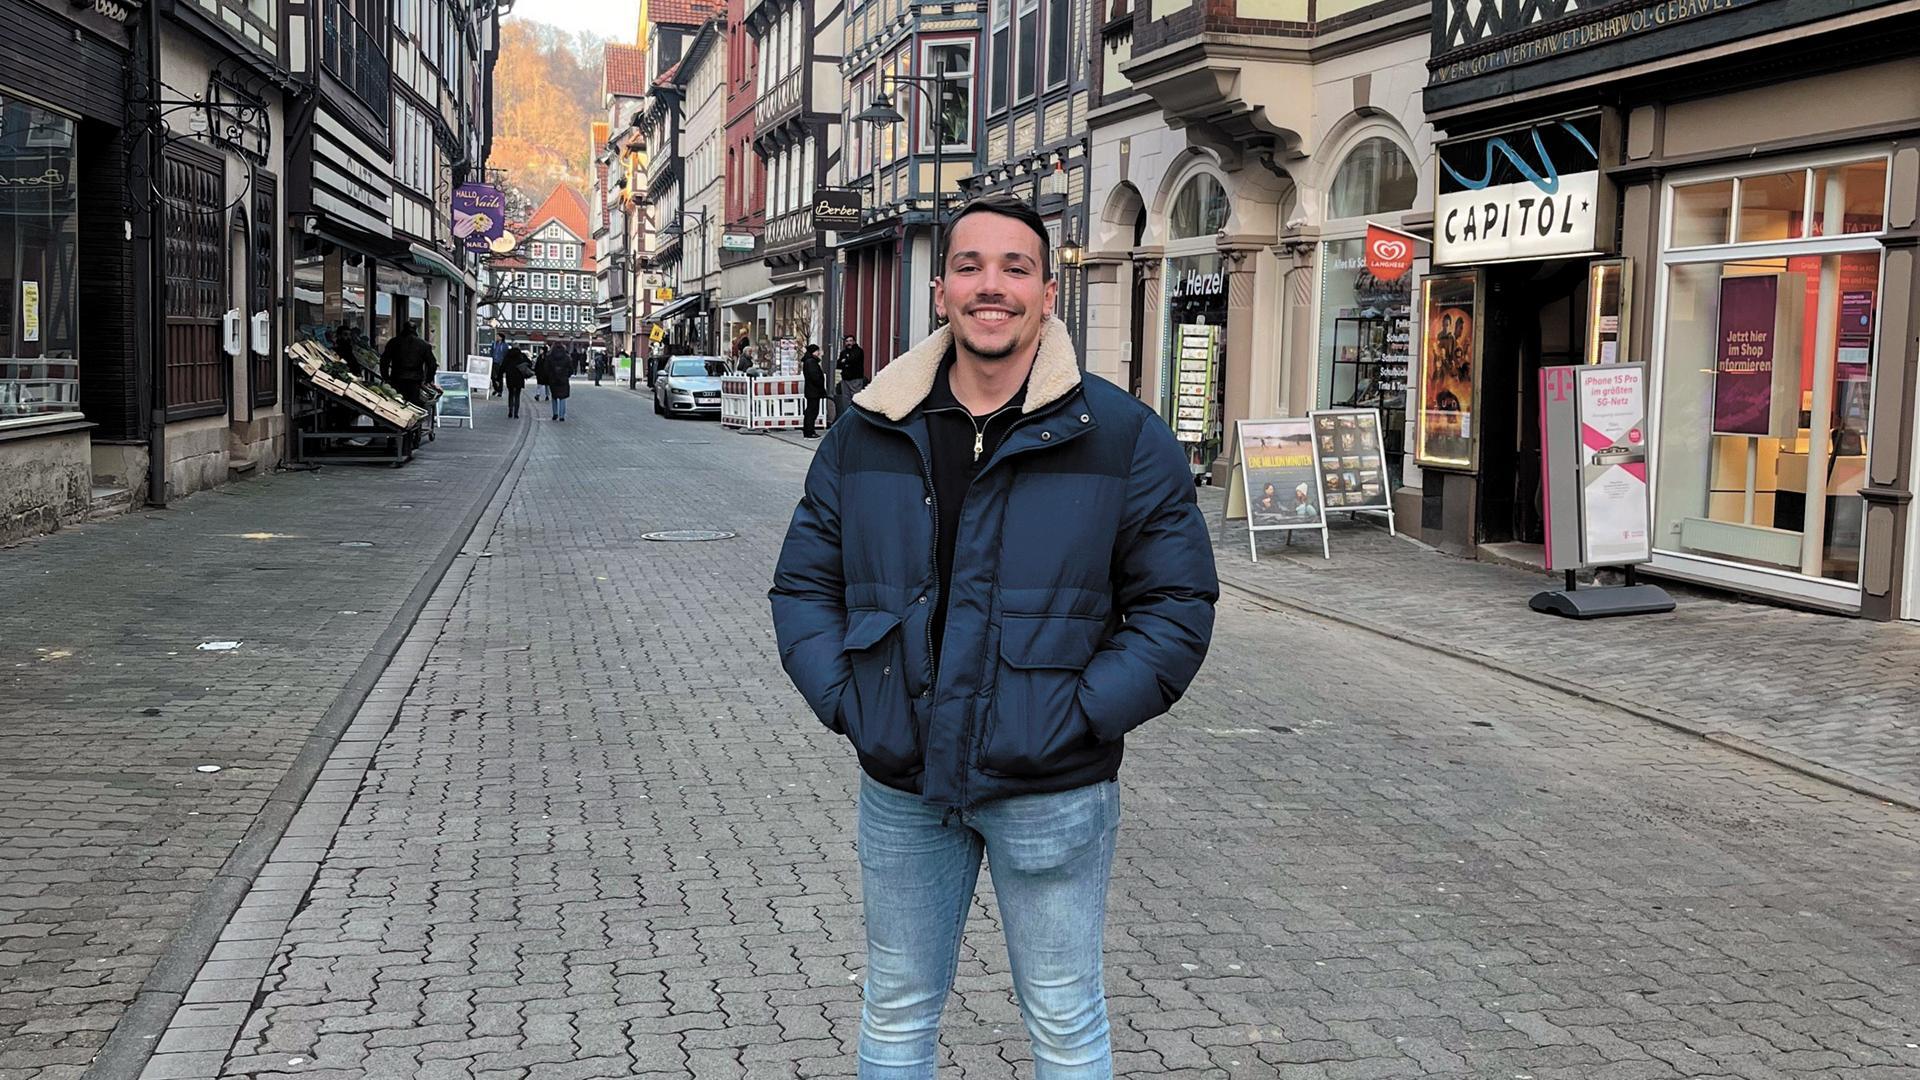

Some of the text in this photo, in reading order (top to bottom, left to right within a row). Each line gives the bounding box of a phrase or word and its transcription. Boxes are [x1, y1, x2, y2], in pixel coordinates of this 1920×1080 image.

[455, 190, 477, 199] HALLO
[464, 195, 500, 208] Nails
[815, 200, 859, 216] Berber
[1444, 194, 1574, 244] CAPITOL
[466, 241, 488, 249] NAILS
[1173, 266, 1225, 297] J. Herzel
[1727, 330, 1767, 342] Jetzt hier
[1728, 343, 1763, 358] im Shop
[1584, 374, 1639, 385] iPhone 15 Pro
[1602, 386, 1633, 397] größten
[1597, 398, 1629, 407] 5G-Netz
